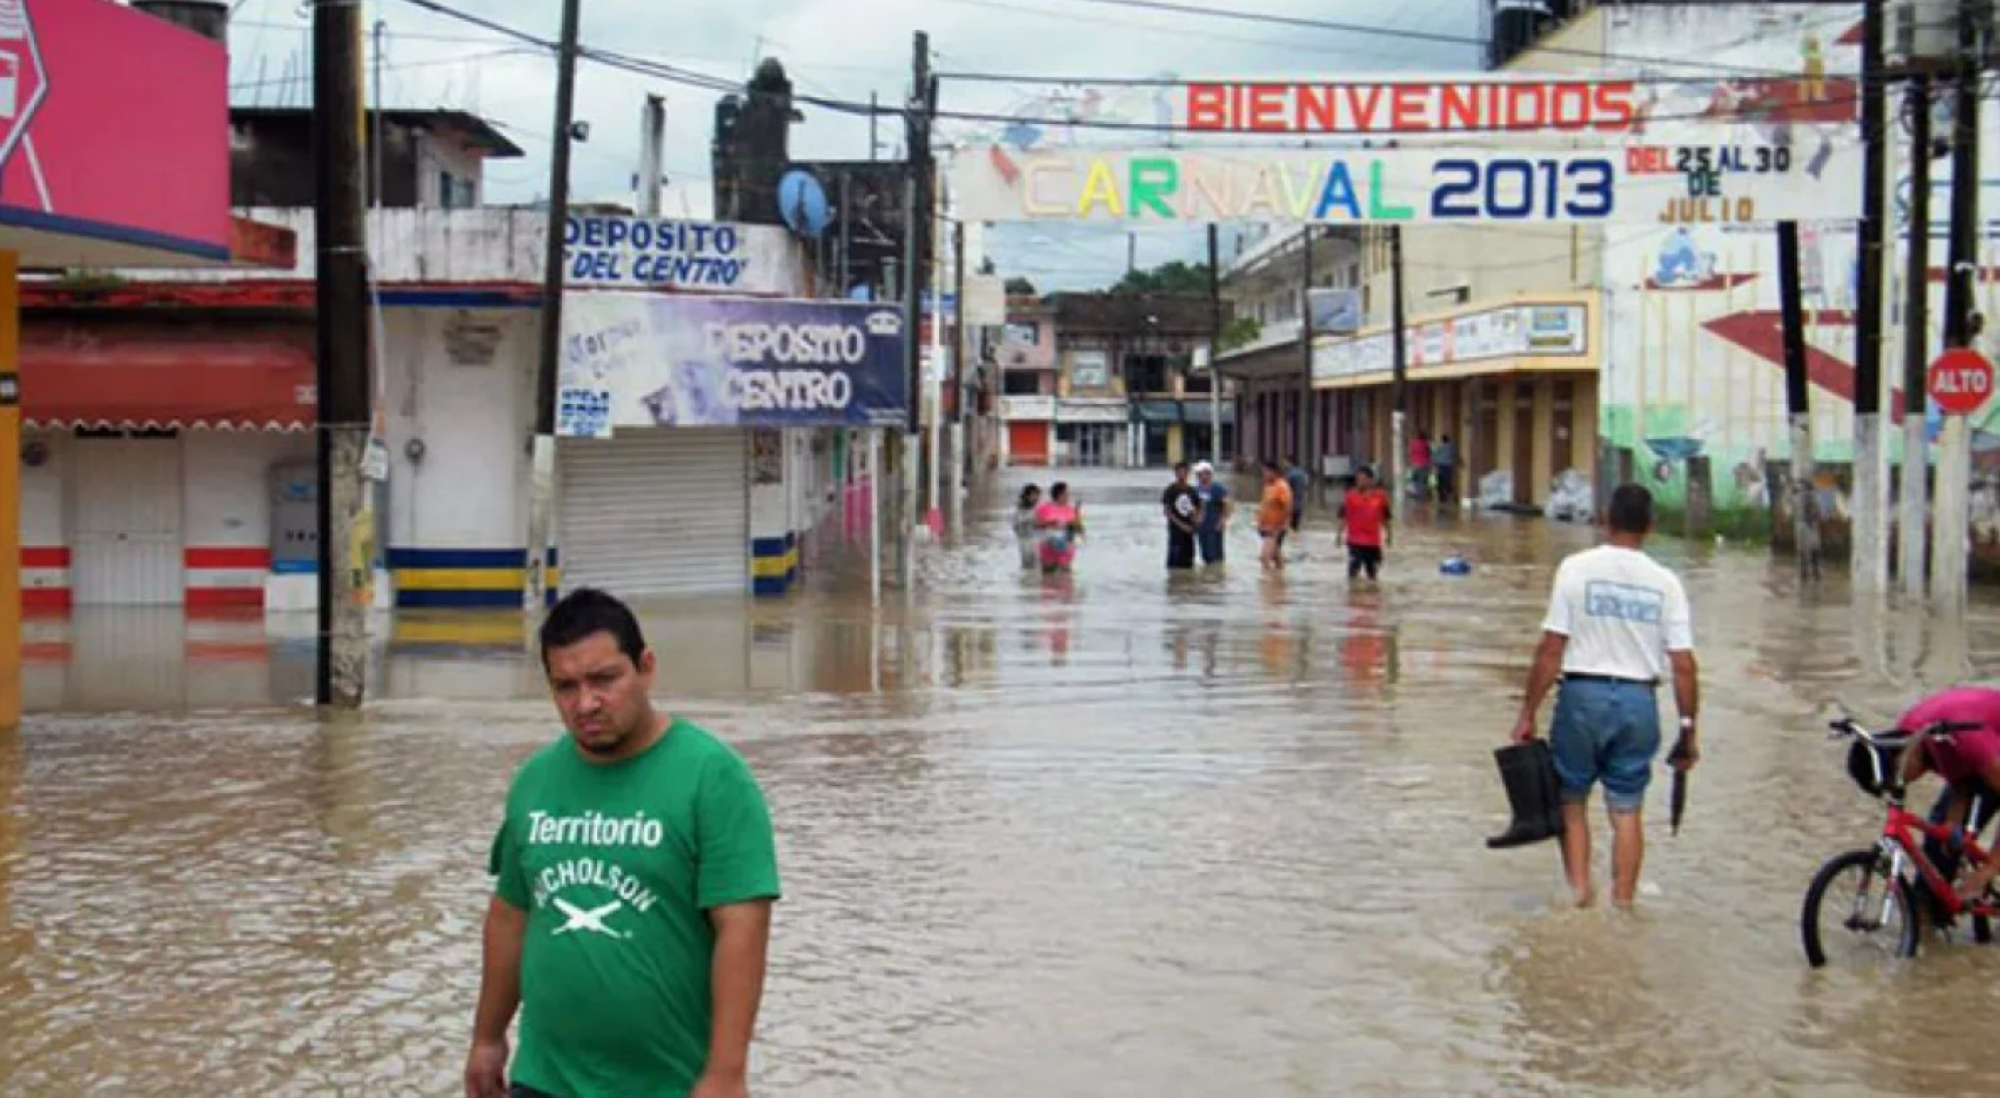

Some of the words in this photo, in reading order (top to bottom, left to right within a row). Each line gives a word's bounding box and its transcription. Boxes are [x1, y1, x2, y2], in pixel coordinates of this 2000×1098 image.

[1186, 82, 1635, 133] BIENVENIDOS
[1627, 147, 1675, 174] DEL
[1676, 147, 1712, 173] 25
[1718, 147, 1748, 172] AL
[1755, 147, 1790, 172] 30
[1024, 156, 1414, 221] CARNAVAL
[1431, 158, 1614, 220] 2013
[1689, 171, 1721, 197] DE
[1659, 198, 1755, 223] JULIO
[564, 218, 737, 255] DEPOSITO
[705, 322, 866, 363] DEPOSITO
[722, 368, 853, 410] CENTRO
[1933, 369, 1988, 394] ALTO
[528, 809, 663, 846] Territorio
